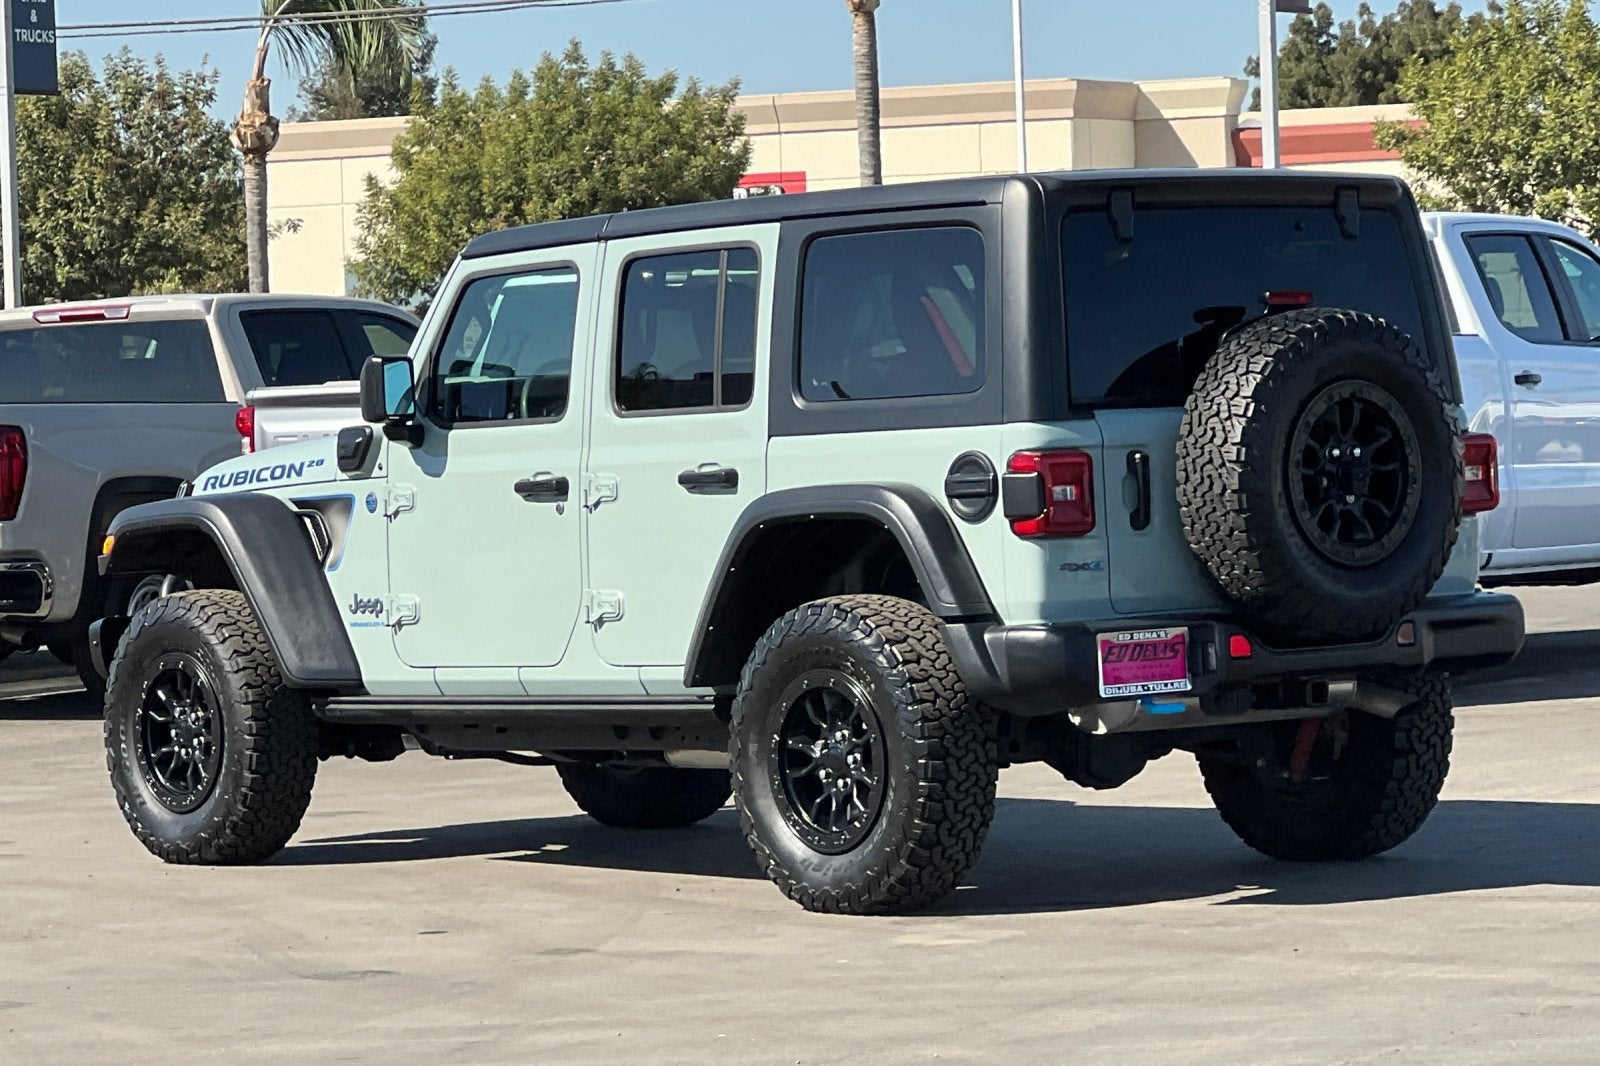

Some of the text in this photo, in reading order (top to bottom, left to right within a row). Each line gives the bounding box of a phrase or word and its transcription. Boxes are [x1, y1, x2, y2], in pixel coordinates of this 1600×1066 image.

[30, 9, 38, 22] &
[14, 28, 55, 43] TRUCKS
[202, 461, 305, 492] RUBICON
[348, 593, 384, 618] Jeep
[1118, 633, 1131, 641] ED
[1148, 681, 1186, 692] TULARE
